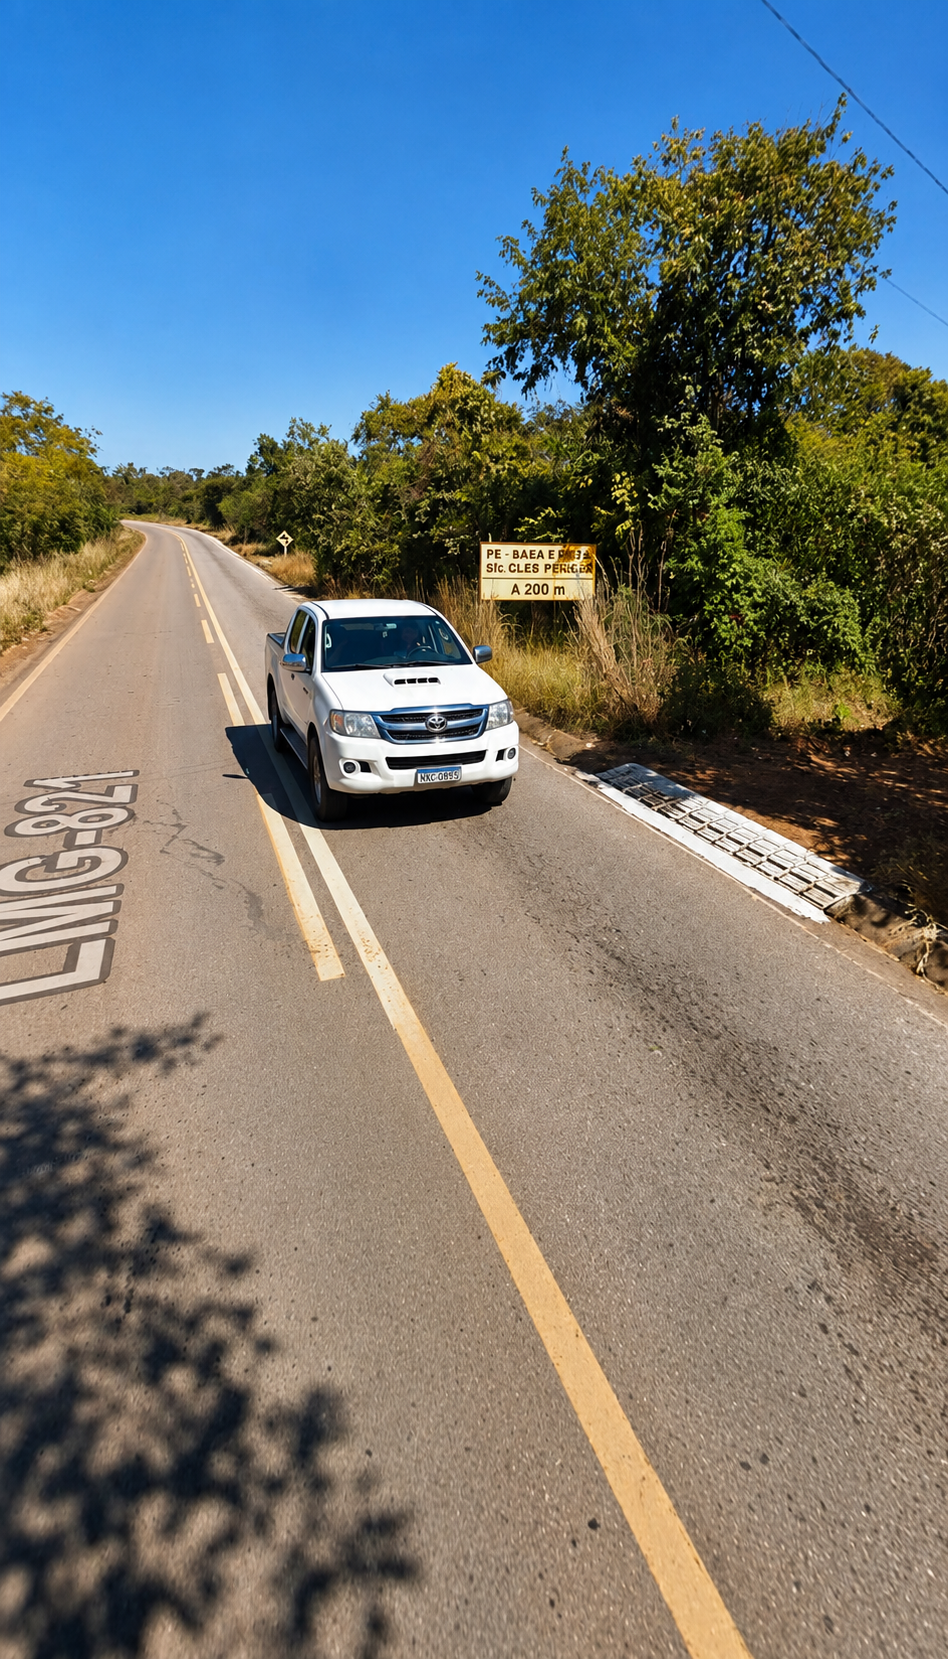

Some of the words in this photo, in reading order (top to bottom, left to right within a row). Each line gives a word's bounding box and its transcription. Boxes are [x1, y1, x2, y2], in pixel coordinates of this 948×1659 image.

[486, 549, 501, 559] PE
[508, 563, 539, 573] CLES
[511, 583, 520, 595] A
[524, 583, 549, 595] 200
[554, 585, 565, 595] m
